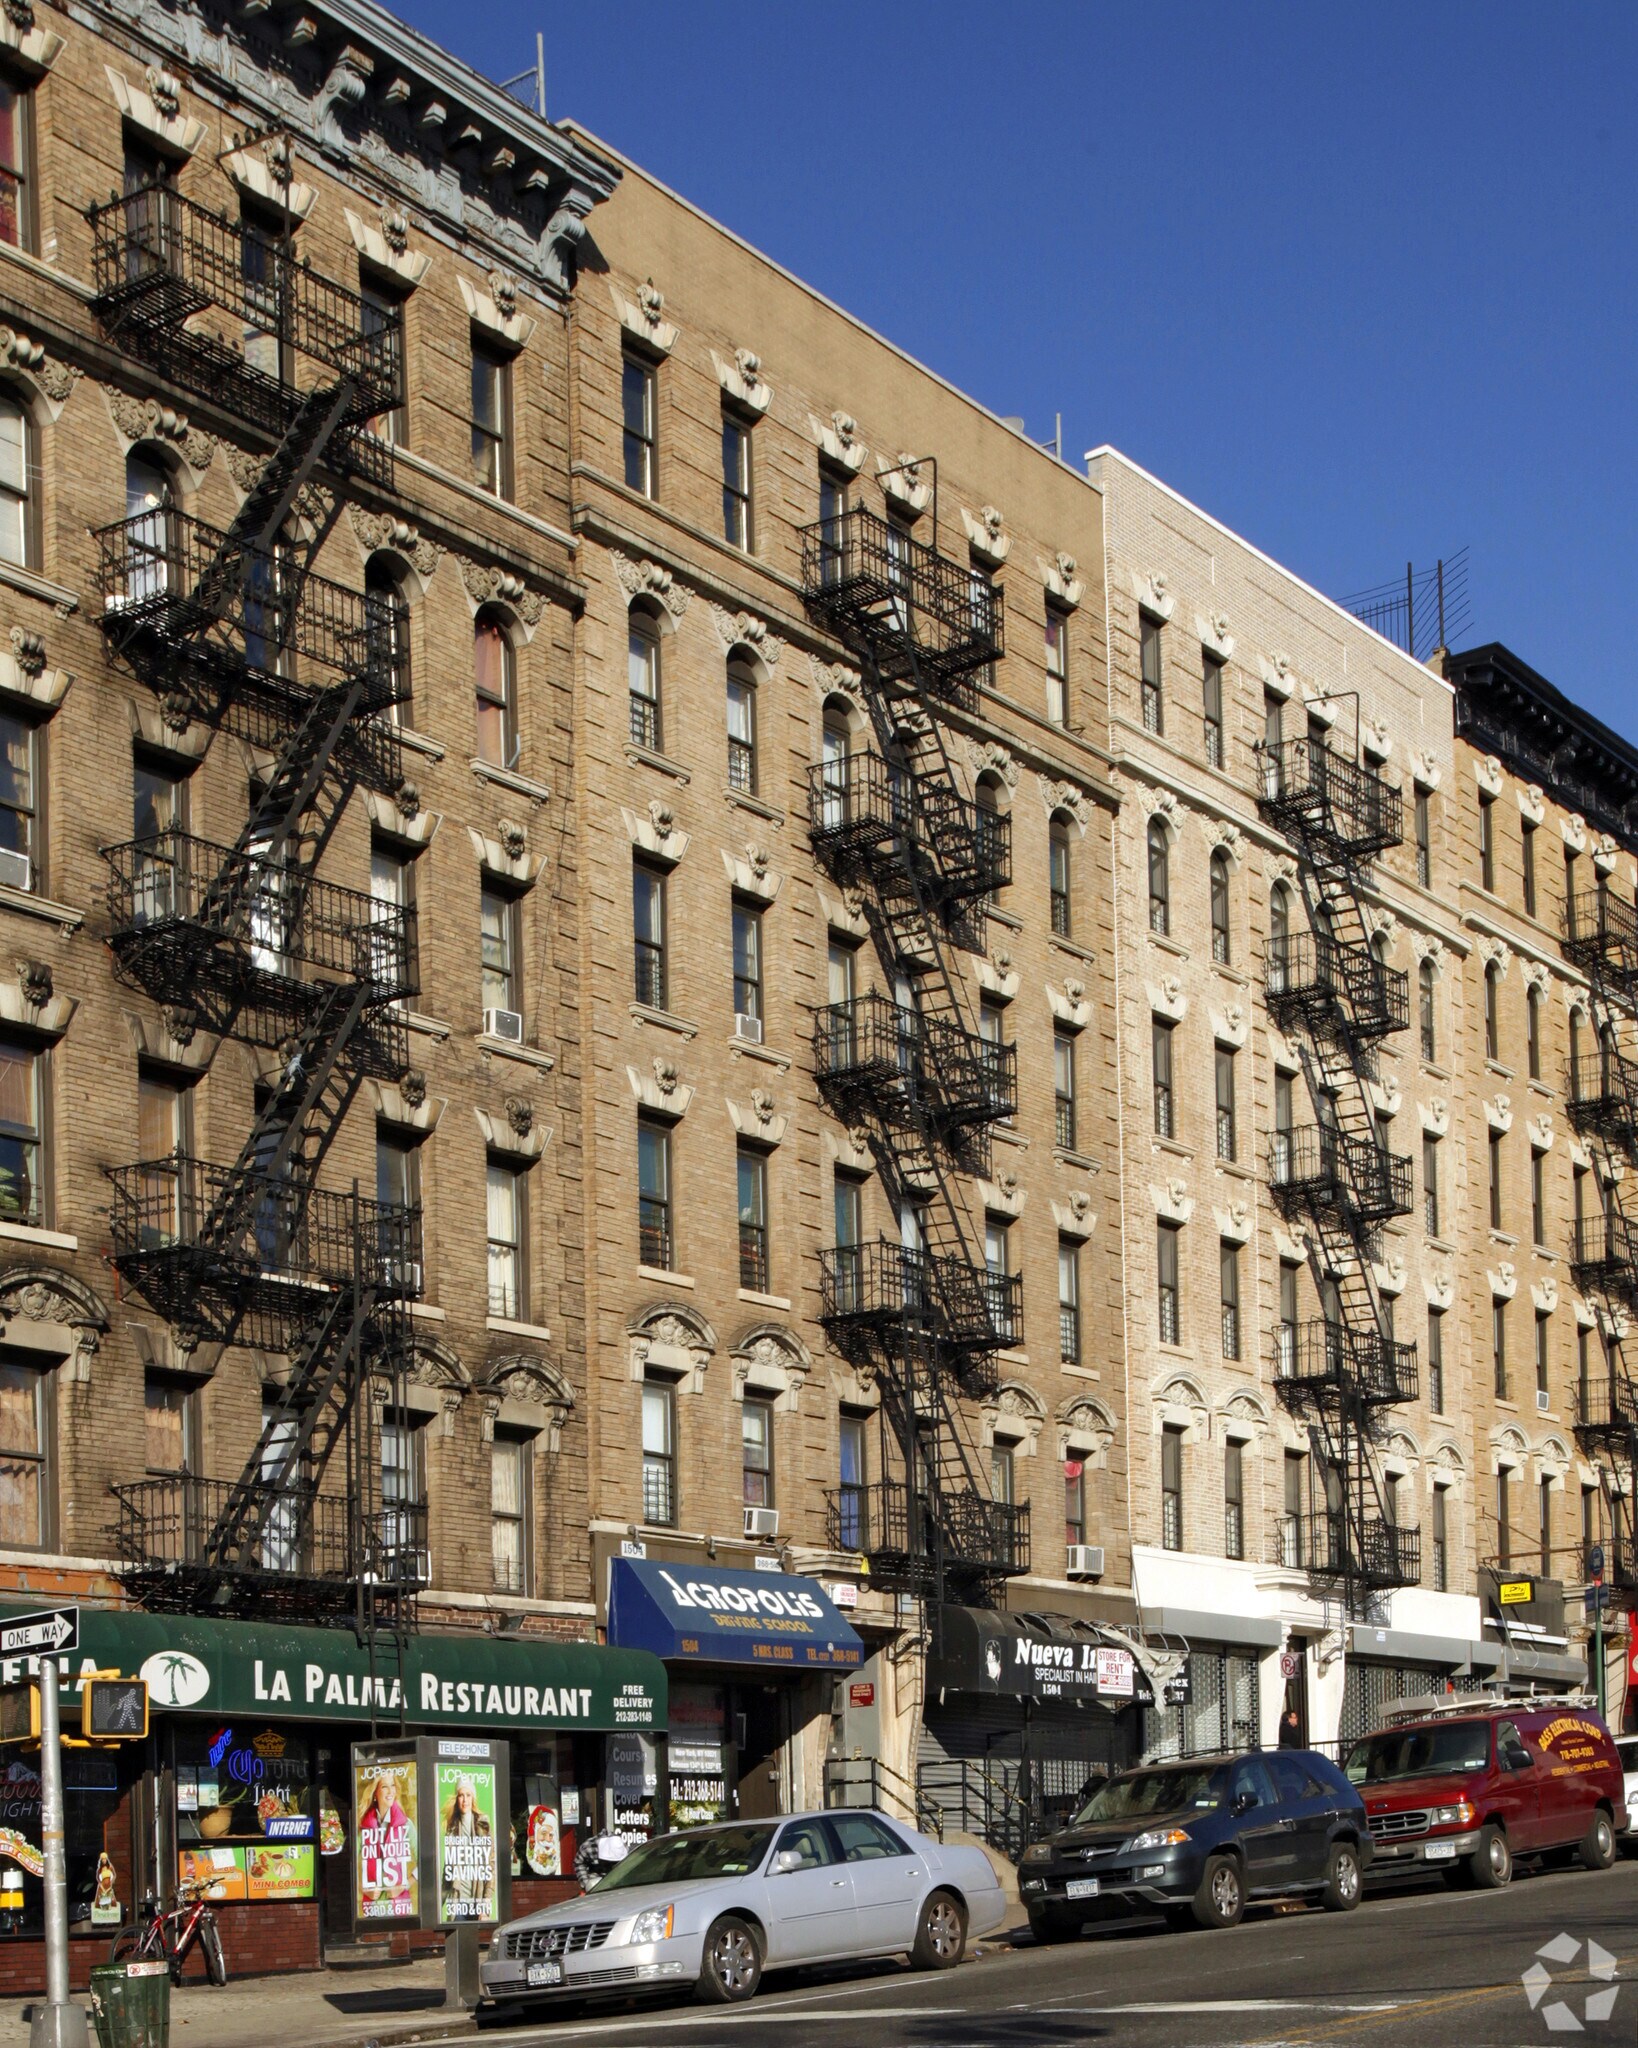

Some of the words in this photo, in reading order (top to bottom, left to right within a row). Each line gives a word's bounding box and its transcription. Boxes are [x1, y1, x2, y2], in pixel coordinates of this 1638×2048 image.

[710, 1614, 762, 1630] DRIVING
[762, 1618, 814, 1633] SCHOOL
[8, 1629, 31, 1647] ONE
[42, 1623, 65, 1641] WAY
[1015, 1638, 1074, 1667] Nueva
[1099, 1650, 1118, 1662] STORE
[1118, 1652, 1131, 1664] FOR
[1034, 1667, 1075, 1683] SPECIALIST
[1075, 1671, 1083, 1683] IN
[1105, 1663, 1125, 1675] RENT
[254, 1660, 292, 1702] LA
[305, 1664, 408, 1710] PALMA
[421, 1672, 592, 1717] RESTAURANT
[622, 1685, 644, 1696] FREE
[1042, 1684, 1062, 1696] 1504
[1137, 1689, 1152, 1700] Tel:
[613, 1697, 653, 1708] DELIVERY
[439, 1743, 489, 1755] TELEPHONE
[361, 1766, 409, 1781] JCPenney
[441, 1768, 491, 1788] JCPenney
[614, 1809, 650, 1825] Letters
[268, 1821, 312, 1836] INTERNET
[361, 1828, 387, 1845] PUT
[390, 1825, 411, 1843] LIZ
[469, 1836, 492, 1846] LIGHTS
[361, 1844, 378, 1859] ON
[380, 1842, 411, 1858] YOUR
[444, 1847, 492, 1865] MERRY
[361, 1856, 412, 1888] LIST
[445, 1865, 493, 1881] SAVINGS
[252, 1881, 275, 1889] MINI
[277, 1879, 311, 1889] COMBO
[363, 1905, 386, 1917] 33RD
[387, 1904, 394, 1916] &
[395, 1903, 413, 1915] 6TH
[446, 1903, 467, 1916] 33RD
[469, 1903, 476, 1915] &
[476, 1903, 492, 1915] 6TH
